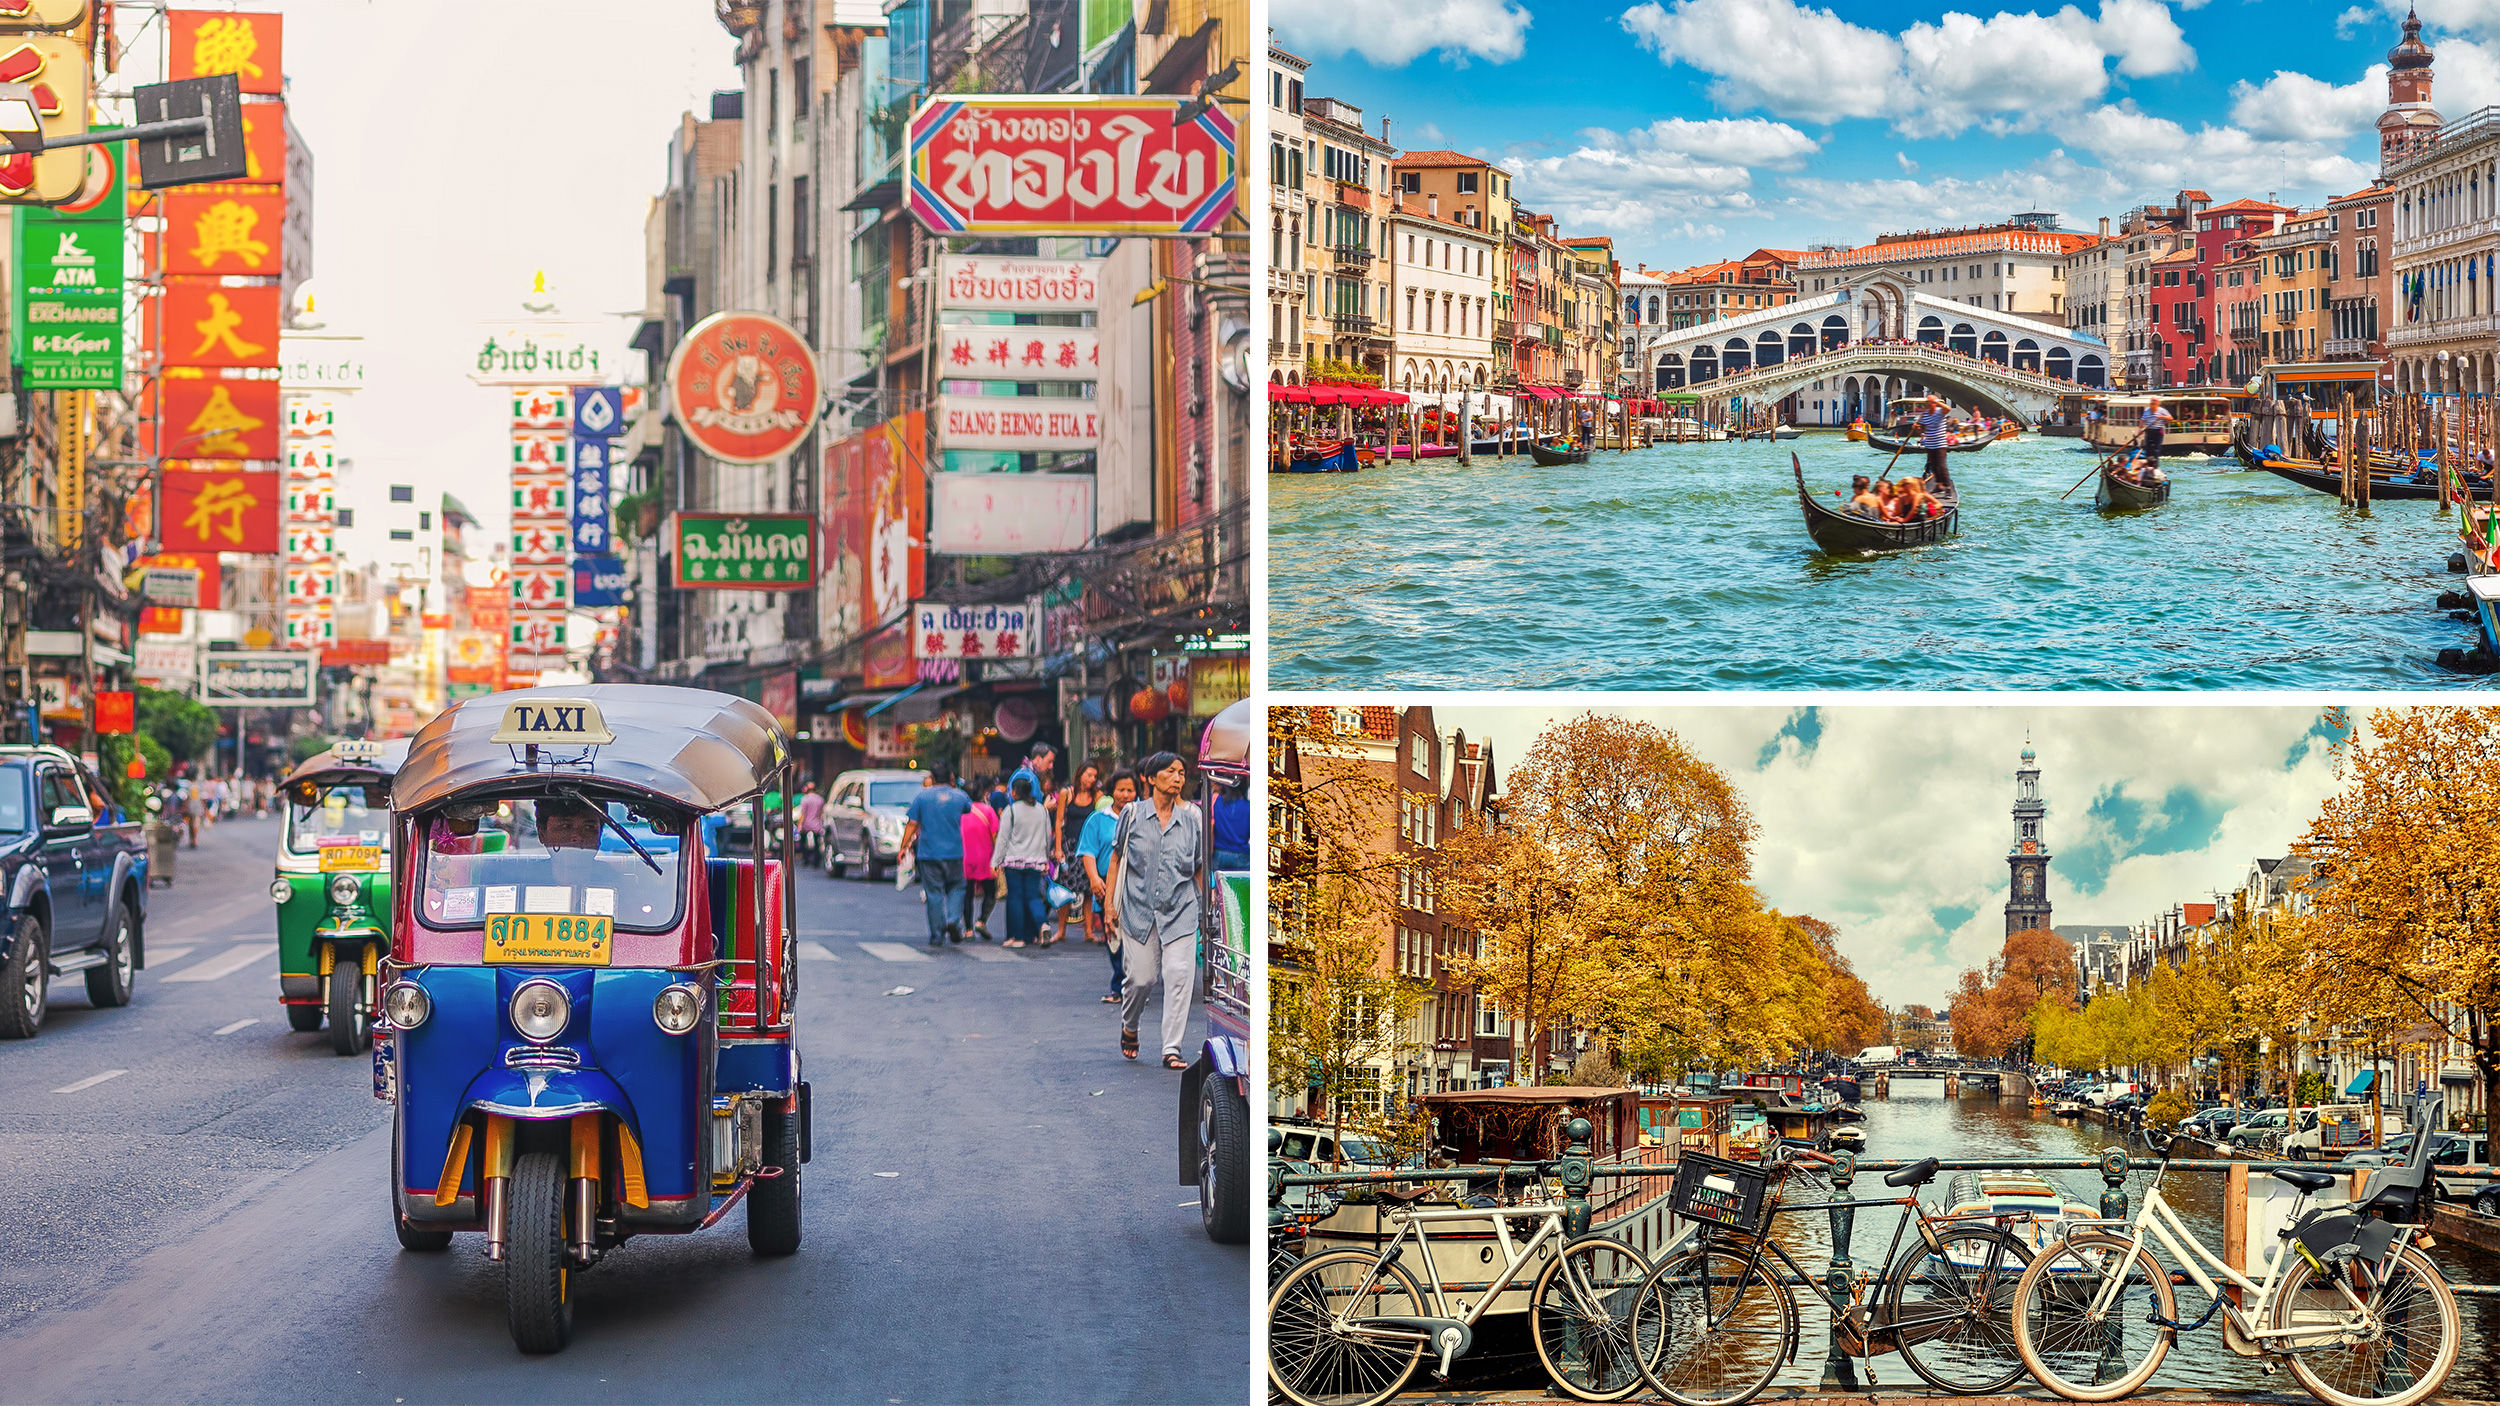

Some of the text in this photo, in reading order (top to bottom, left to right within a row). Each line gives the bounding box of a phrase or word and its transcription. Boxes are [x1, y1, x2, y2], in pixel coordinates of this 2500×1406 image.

[952, 108, 1093, 143] ห้างทอง
[52, 267, 97, 286] ATM
[28, 307, 119, 323] EXCHANGE
[32, 366, 115, 379] WISDOM
[949, 410, 996, 436] SIANG
[1000, 412, 1044, 437] HENG
[1048, 413, 1081, 438] HUA
[514, 706, 586, 732] TAXI
[341, 743, 373, 752] TAXI
[349, 848, 378, 860] 7094
[544, 917, 606, 944] 1884
